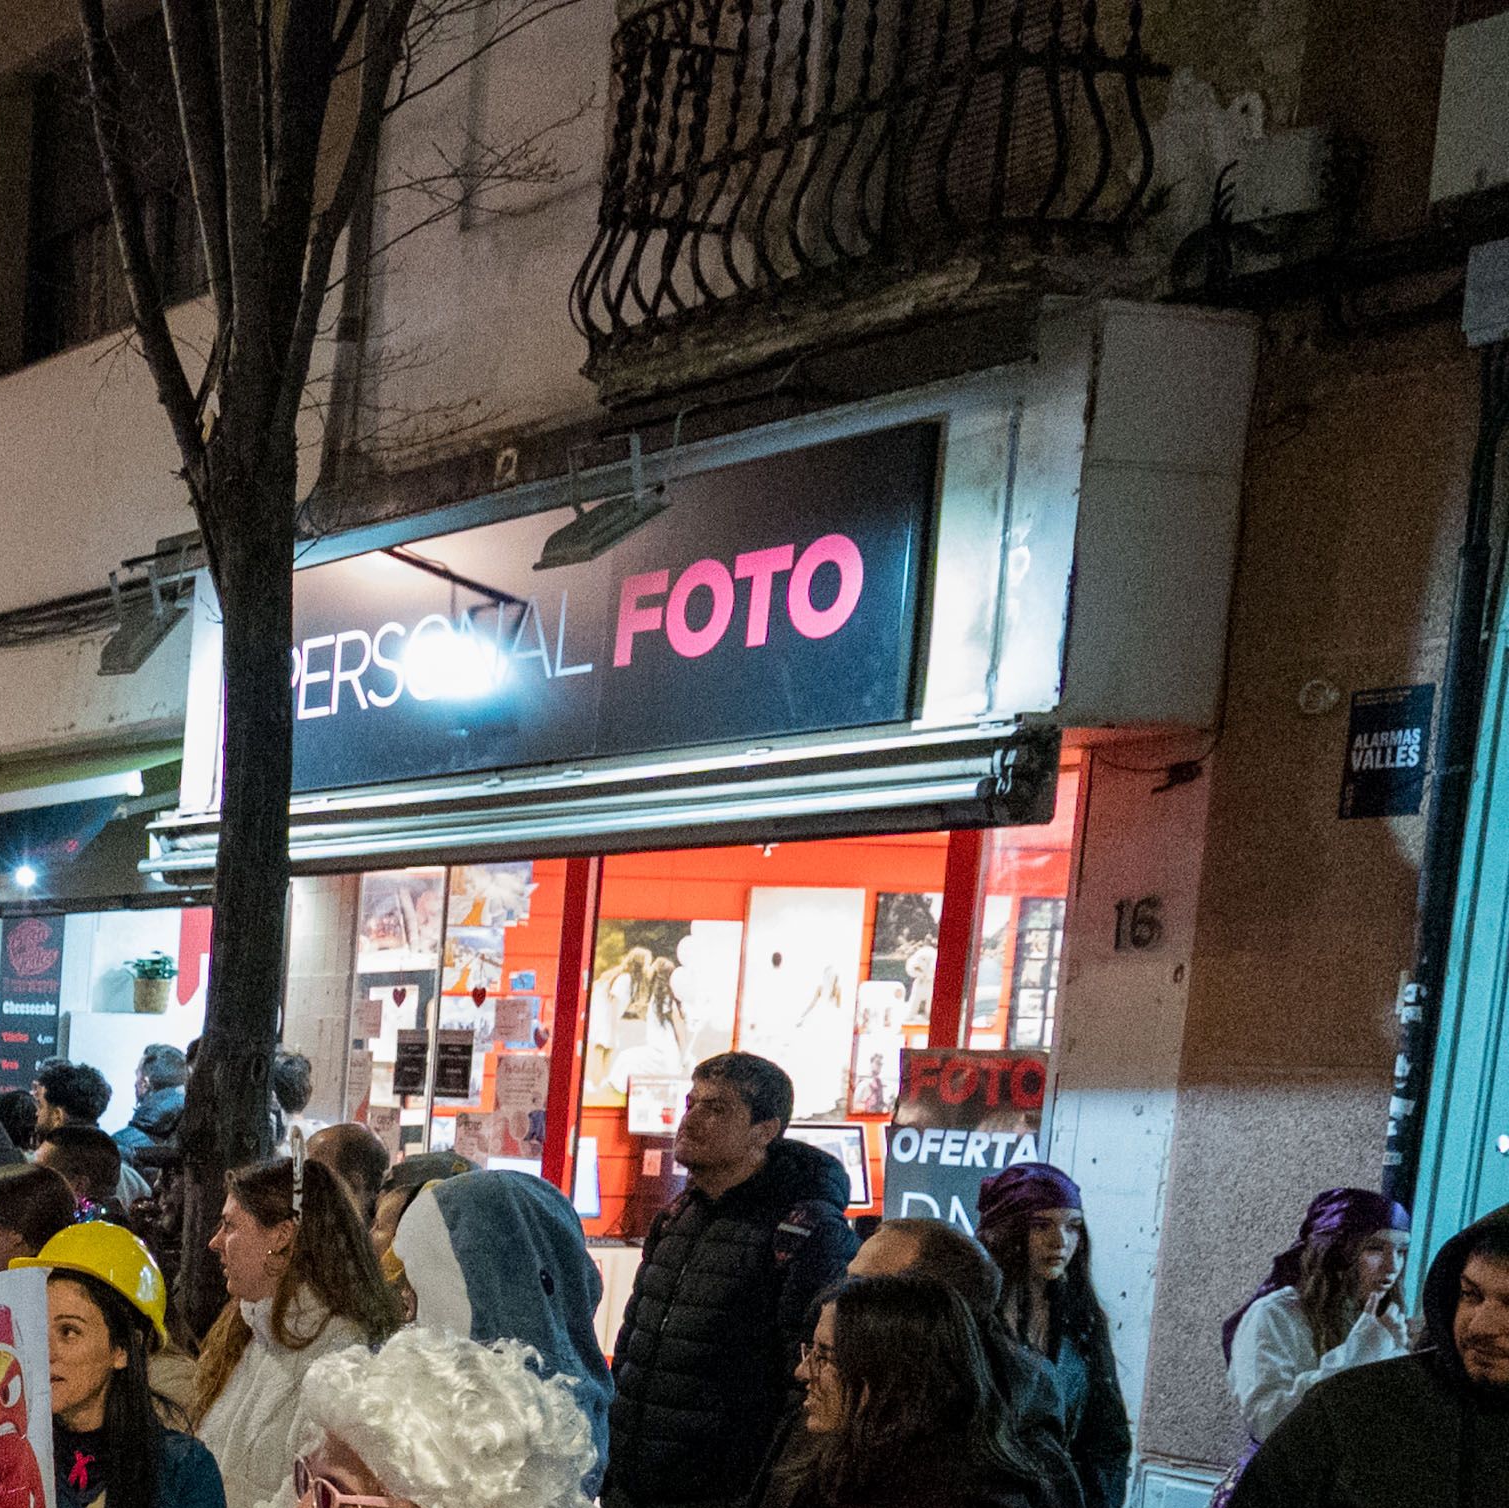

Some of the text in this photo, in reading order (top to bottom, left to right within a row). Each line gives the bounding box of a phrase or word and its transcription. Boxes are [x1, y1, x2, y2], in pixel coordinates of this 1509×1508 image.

[613, 533, 864, 668] FOTO
[1352, 728, 1421, 750] ALARMAS
[1113, 896, 1165, 953] 16
[909, 1056, 1047, 1109] FOTO
[891, 1127, 1039, 1169] OFERTA
